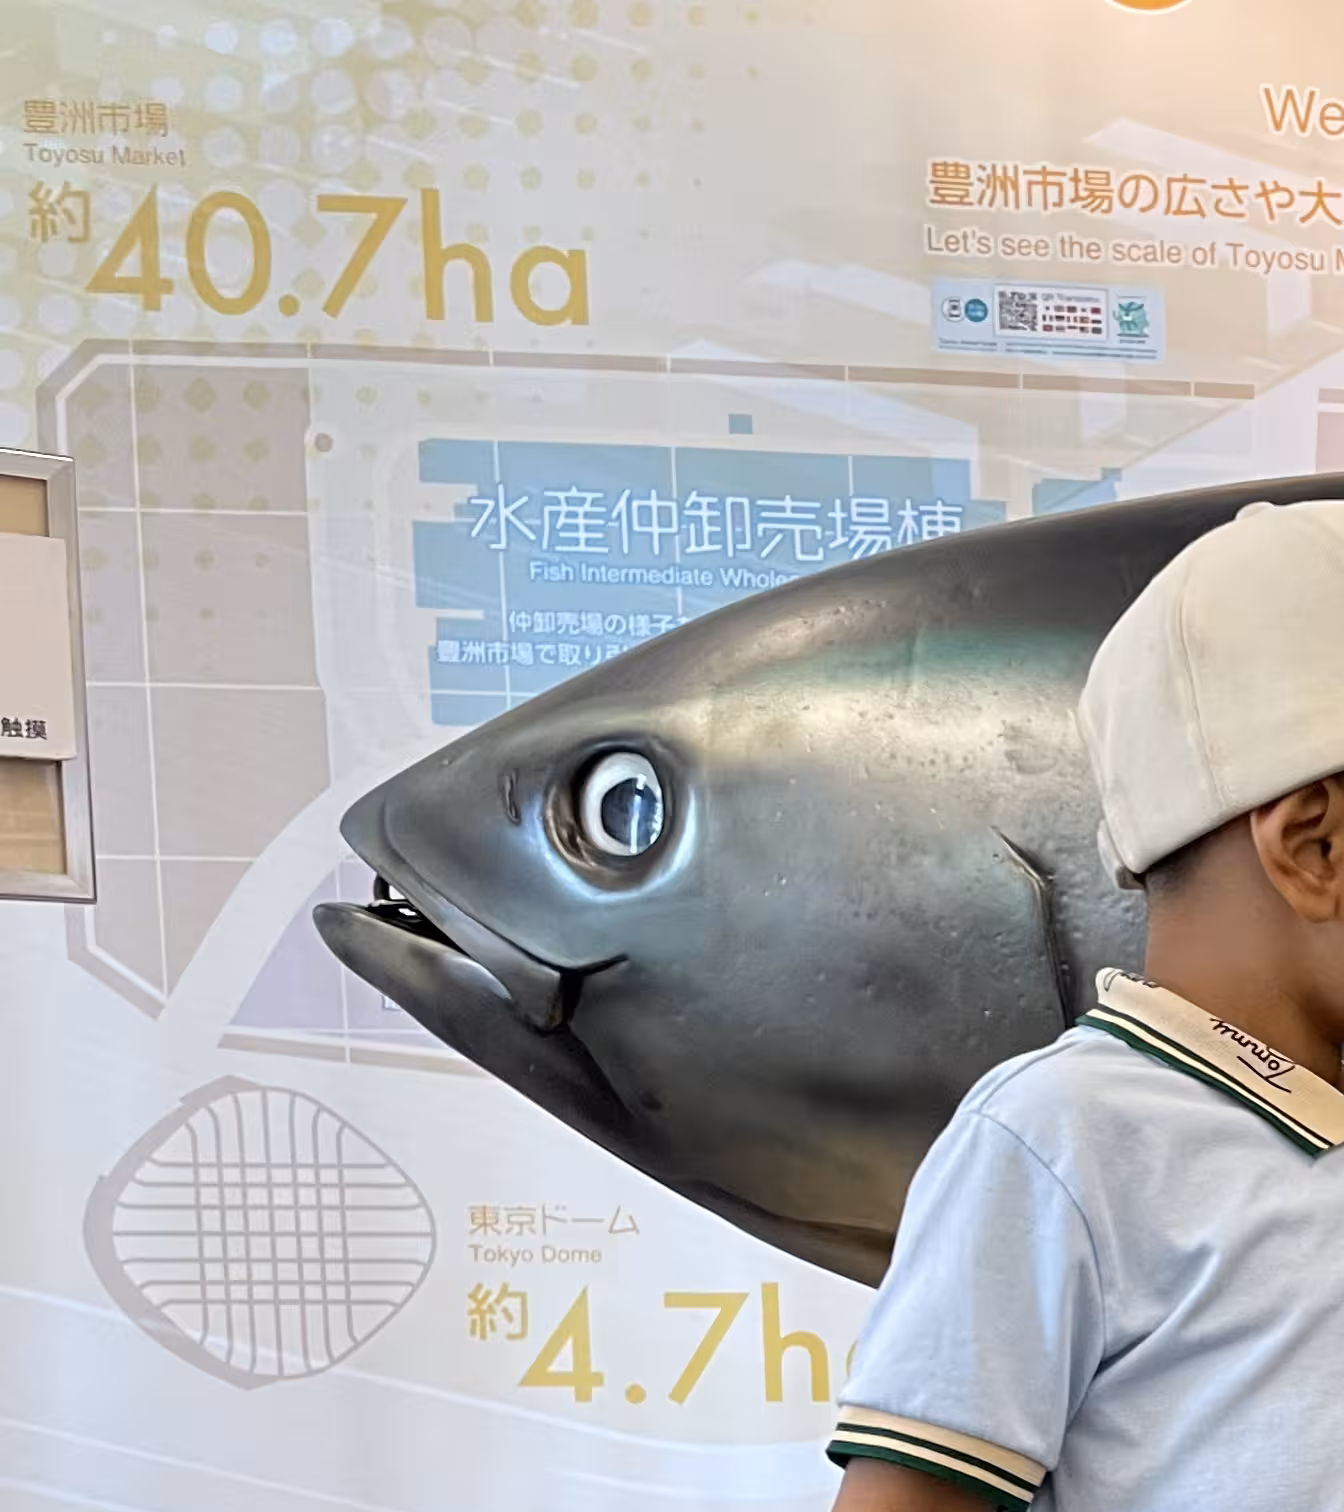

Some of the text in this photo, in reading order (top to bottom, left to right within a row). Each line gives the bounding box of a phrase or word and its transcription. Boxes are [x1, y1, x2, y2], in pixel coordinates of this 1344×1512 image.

[23, 100, 168, 137] 豊洲市場
[23, 143, 187, 167] Toyosu Market
[926, 228, 992, 255] Let's
[1001, 236, 1050, 257] see
[1060, 235, 1101, 259] the
[1112, 241, 1182, 264] scale
[1191, 243, 1217, 264] of
[1225, 243, 1325, 275] Toyosu
[469, 484, 963, 562] 水産仲卸売場棟
[529, 560, 574, 582] Fish
[581, 562, 713, 587] Intermediate
[467, 1203, 640, 1237] 東京ドーム
[468, 1243, 603, 1266] Tokyo Dome
